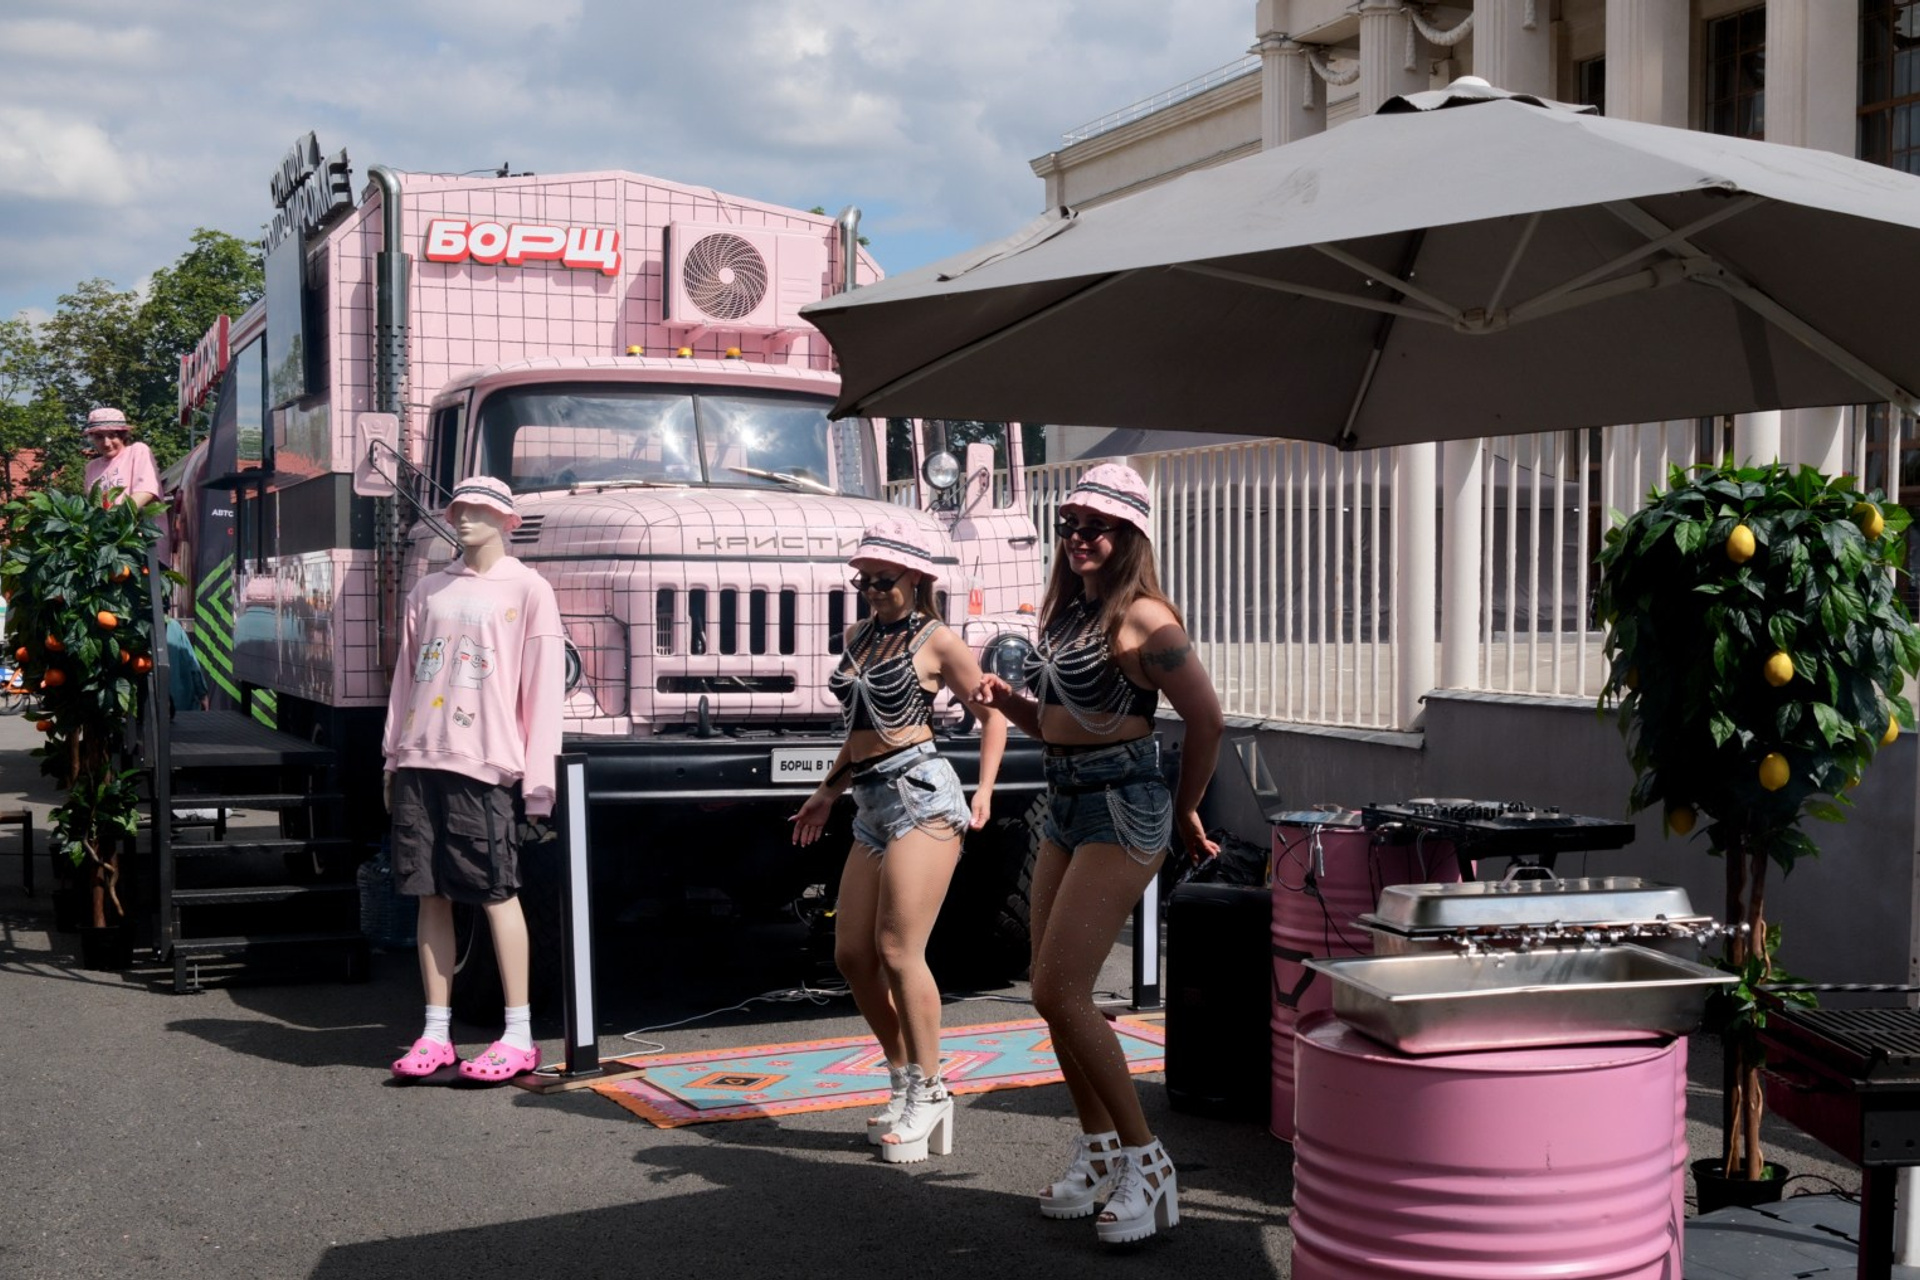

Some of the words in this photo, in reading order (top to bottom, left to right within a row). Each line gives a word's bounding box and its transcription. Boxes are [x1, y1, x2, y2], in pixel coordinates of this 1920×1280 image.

[427, 219, 621, 276] БОРЩ
[780, 760, 812, 771] БОРЩ
[816, 760, 824, 770] В
